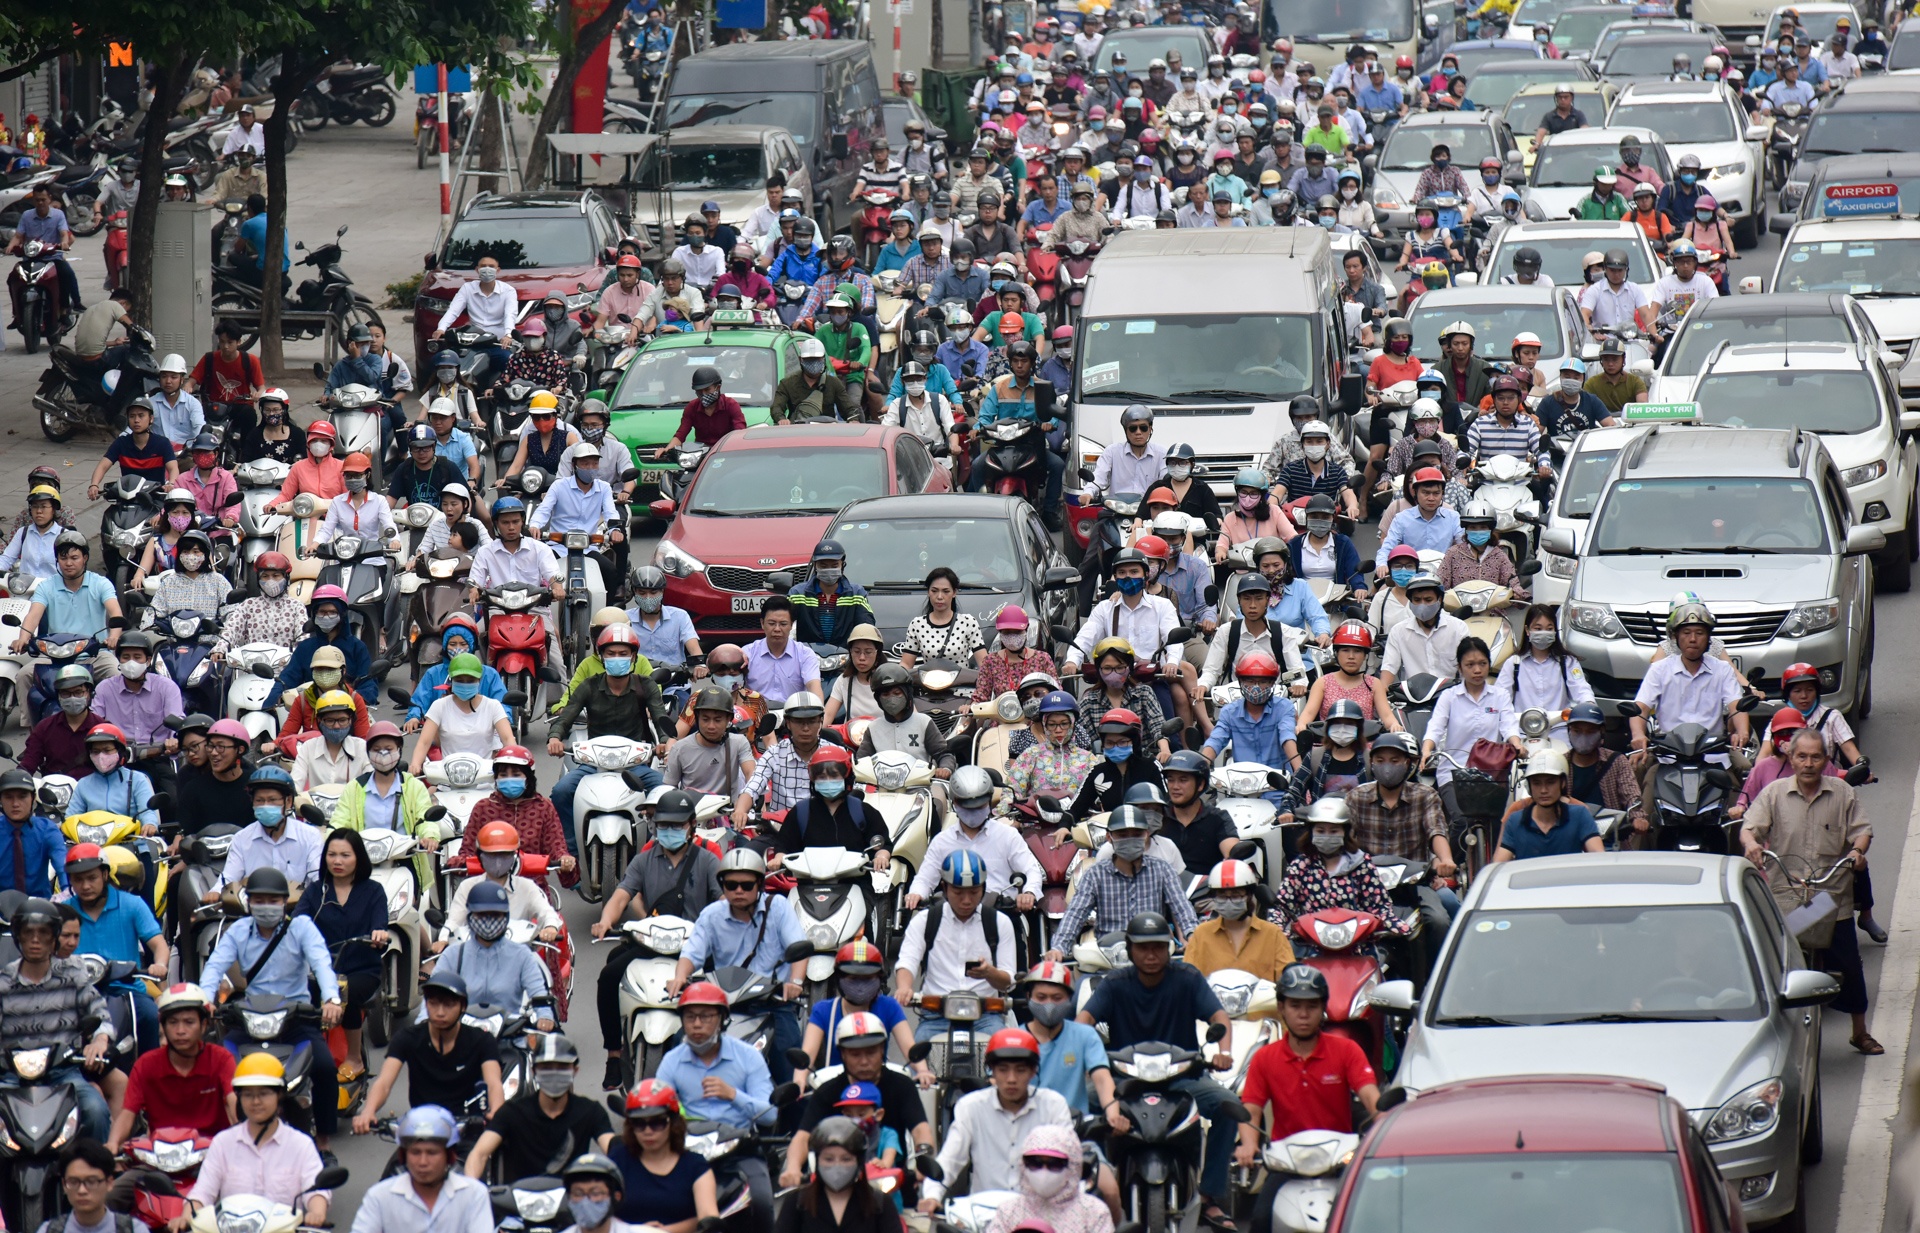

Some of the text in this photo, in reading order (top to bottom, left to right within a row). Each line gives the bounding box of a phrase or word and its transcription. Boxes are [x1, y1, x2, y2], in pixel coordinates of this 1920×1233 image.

[1832, 186, 1893, 196] AIRPORT
[1837, 202, 1896, 211] TAXIGROUP
[1084, 372, 1115, 387] XE 11
[1630, 406, 1642, 414] HA
[1673, 405, 1693, 413] TAXI
[908, 734, 920, 747] X
